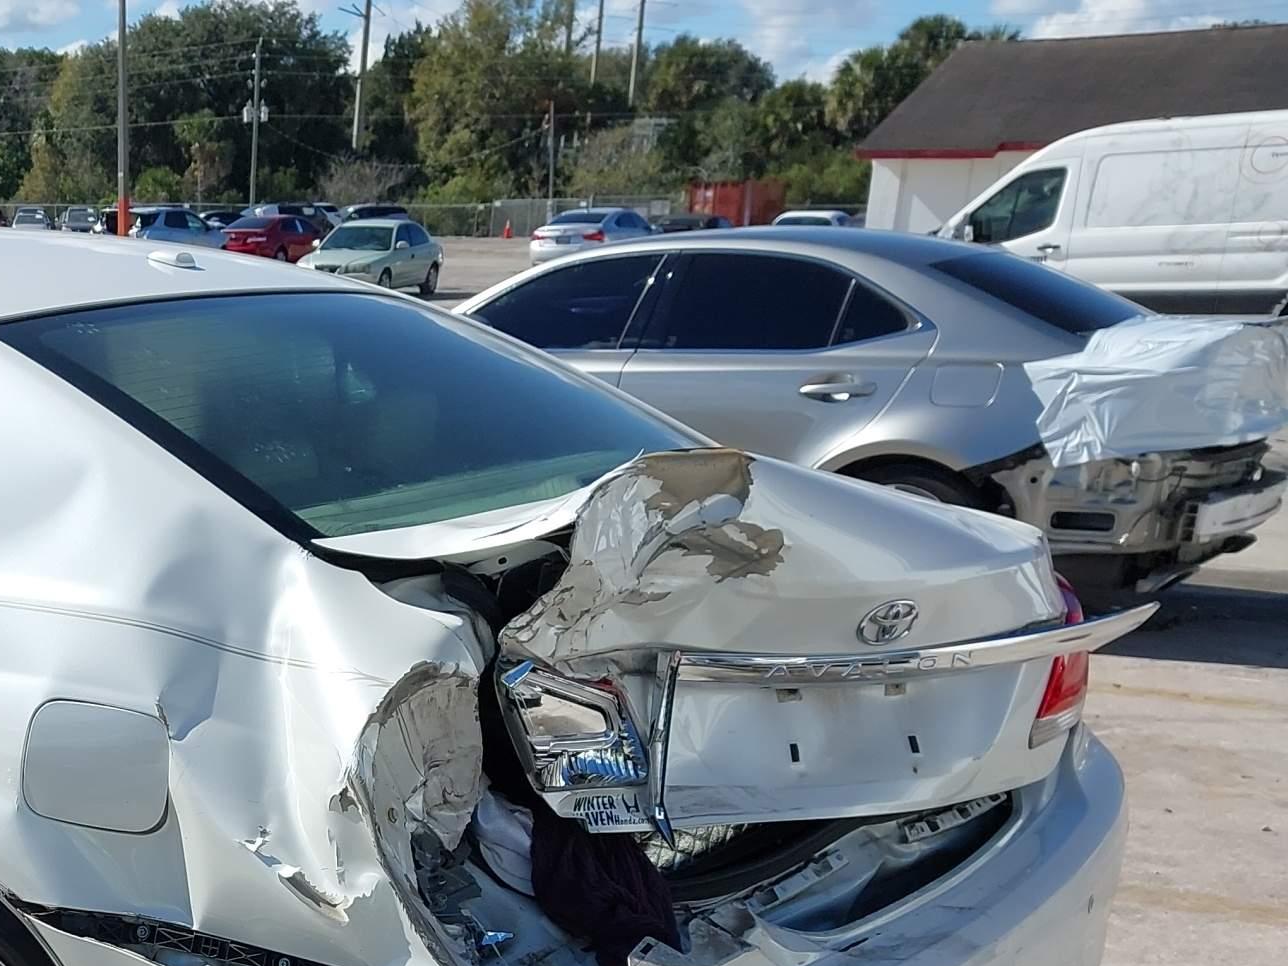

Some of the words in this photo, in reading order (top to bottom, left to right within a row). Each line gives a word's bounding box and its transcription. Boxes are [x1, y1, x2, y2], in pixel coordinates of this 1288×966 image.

[765, 650, 973, 679] AVALON
[573, 795, 617, 812] WINTER
[573, 810, 616, 827] AVEN
